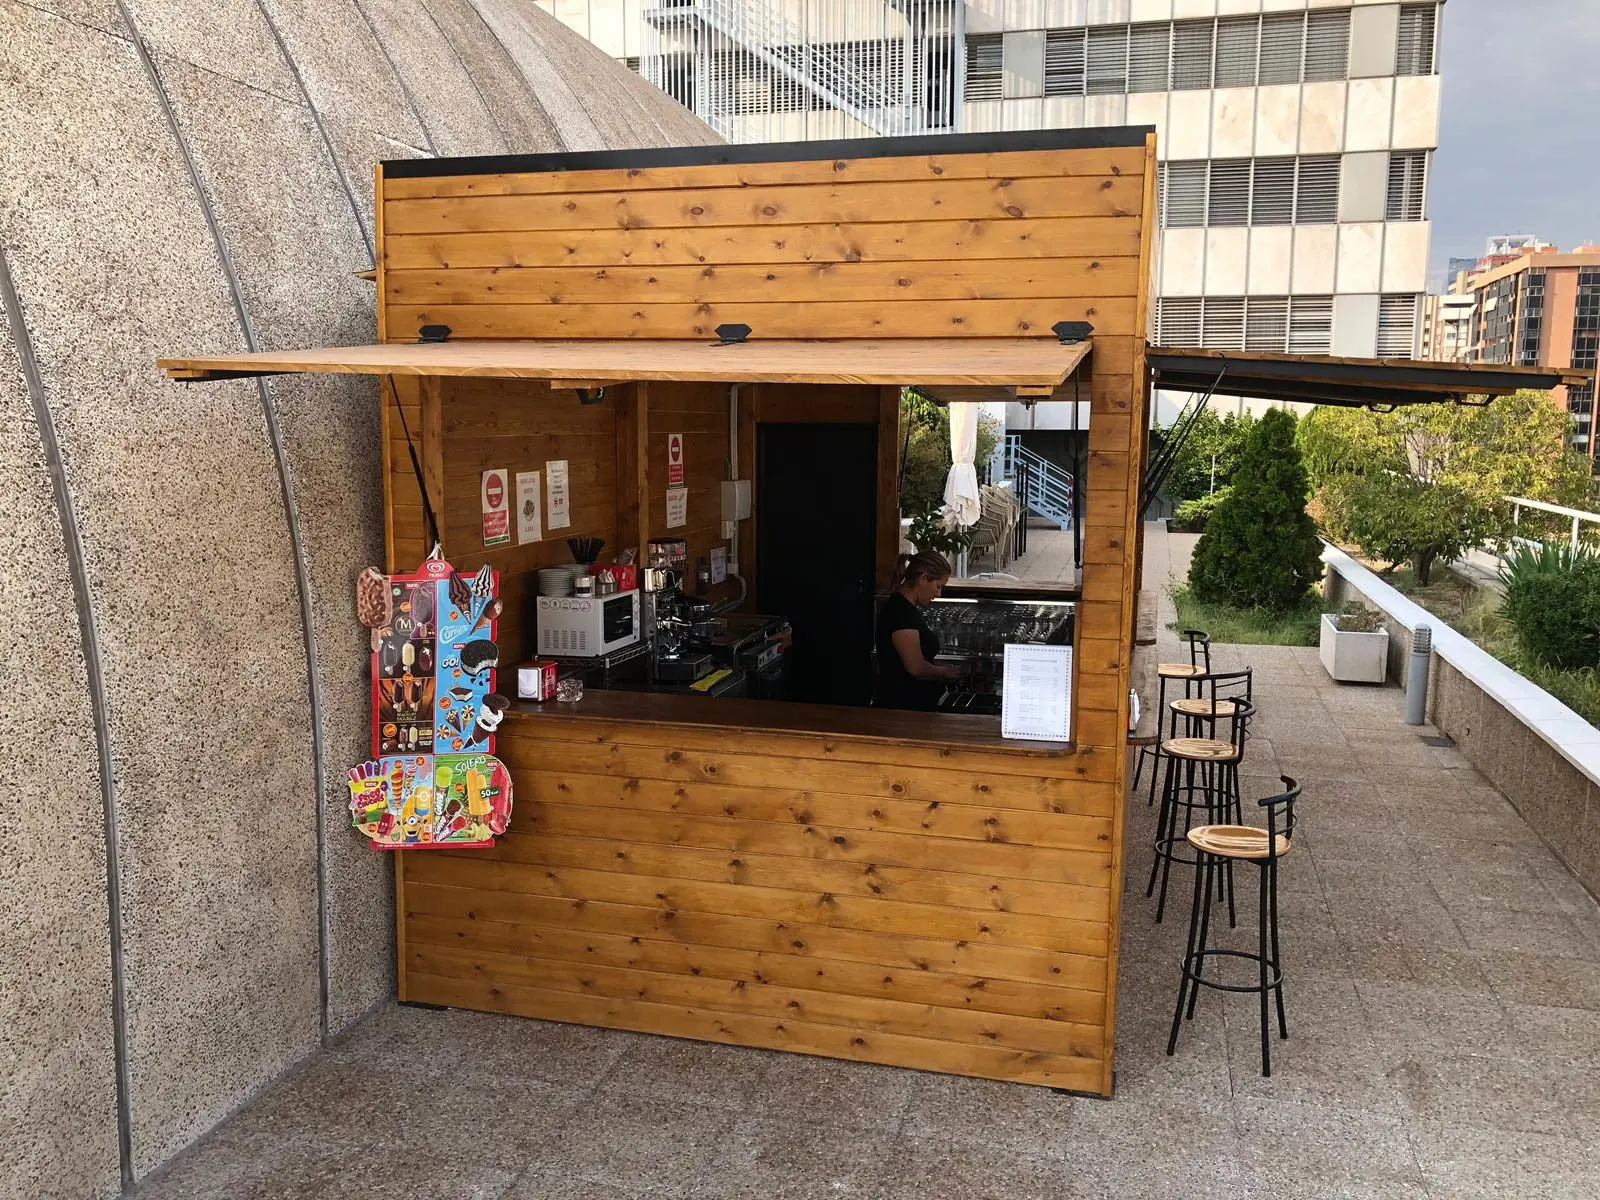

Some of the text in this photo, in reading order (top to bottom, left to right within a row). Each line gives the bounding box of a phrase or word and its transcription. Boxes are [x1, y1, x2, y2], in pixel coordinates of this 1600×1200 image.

[442, 657, 459, 668] GO!
[455, 755, 486, 776] SOLERO
[481, 789, 491, 798] 50
